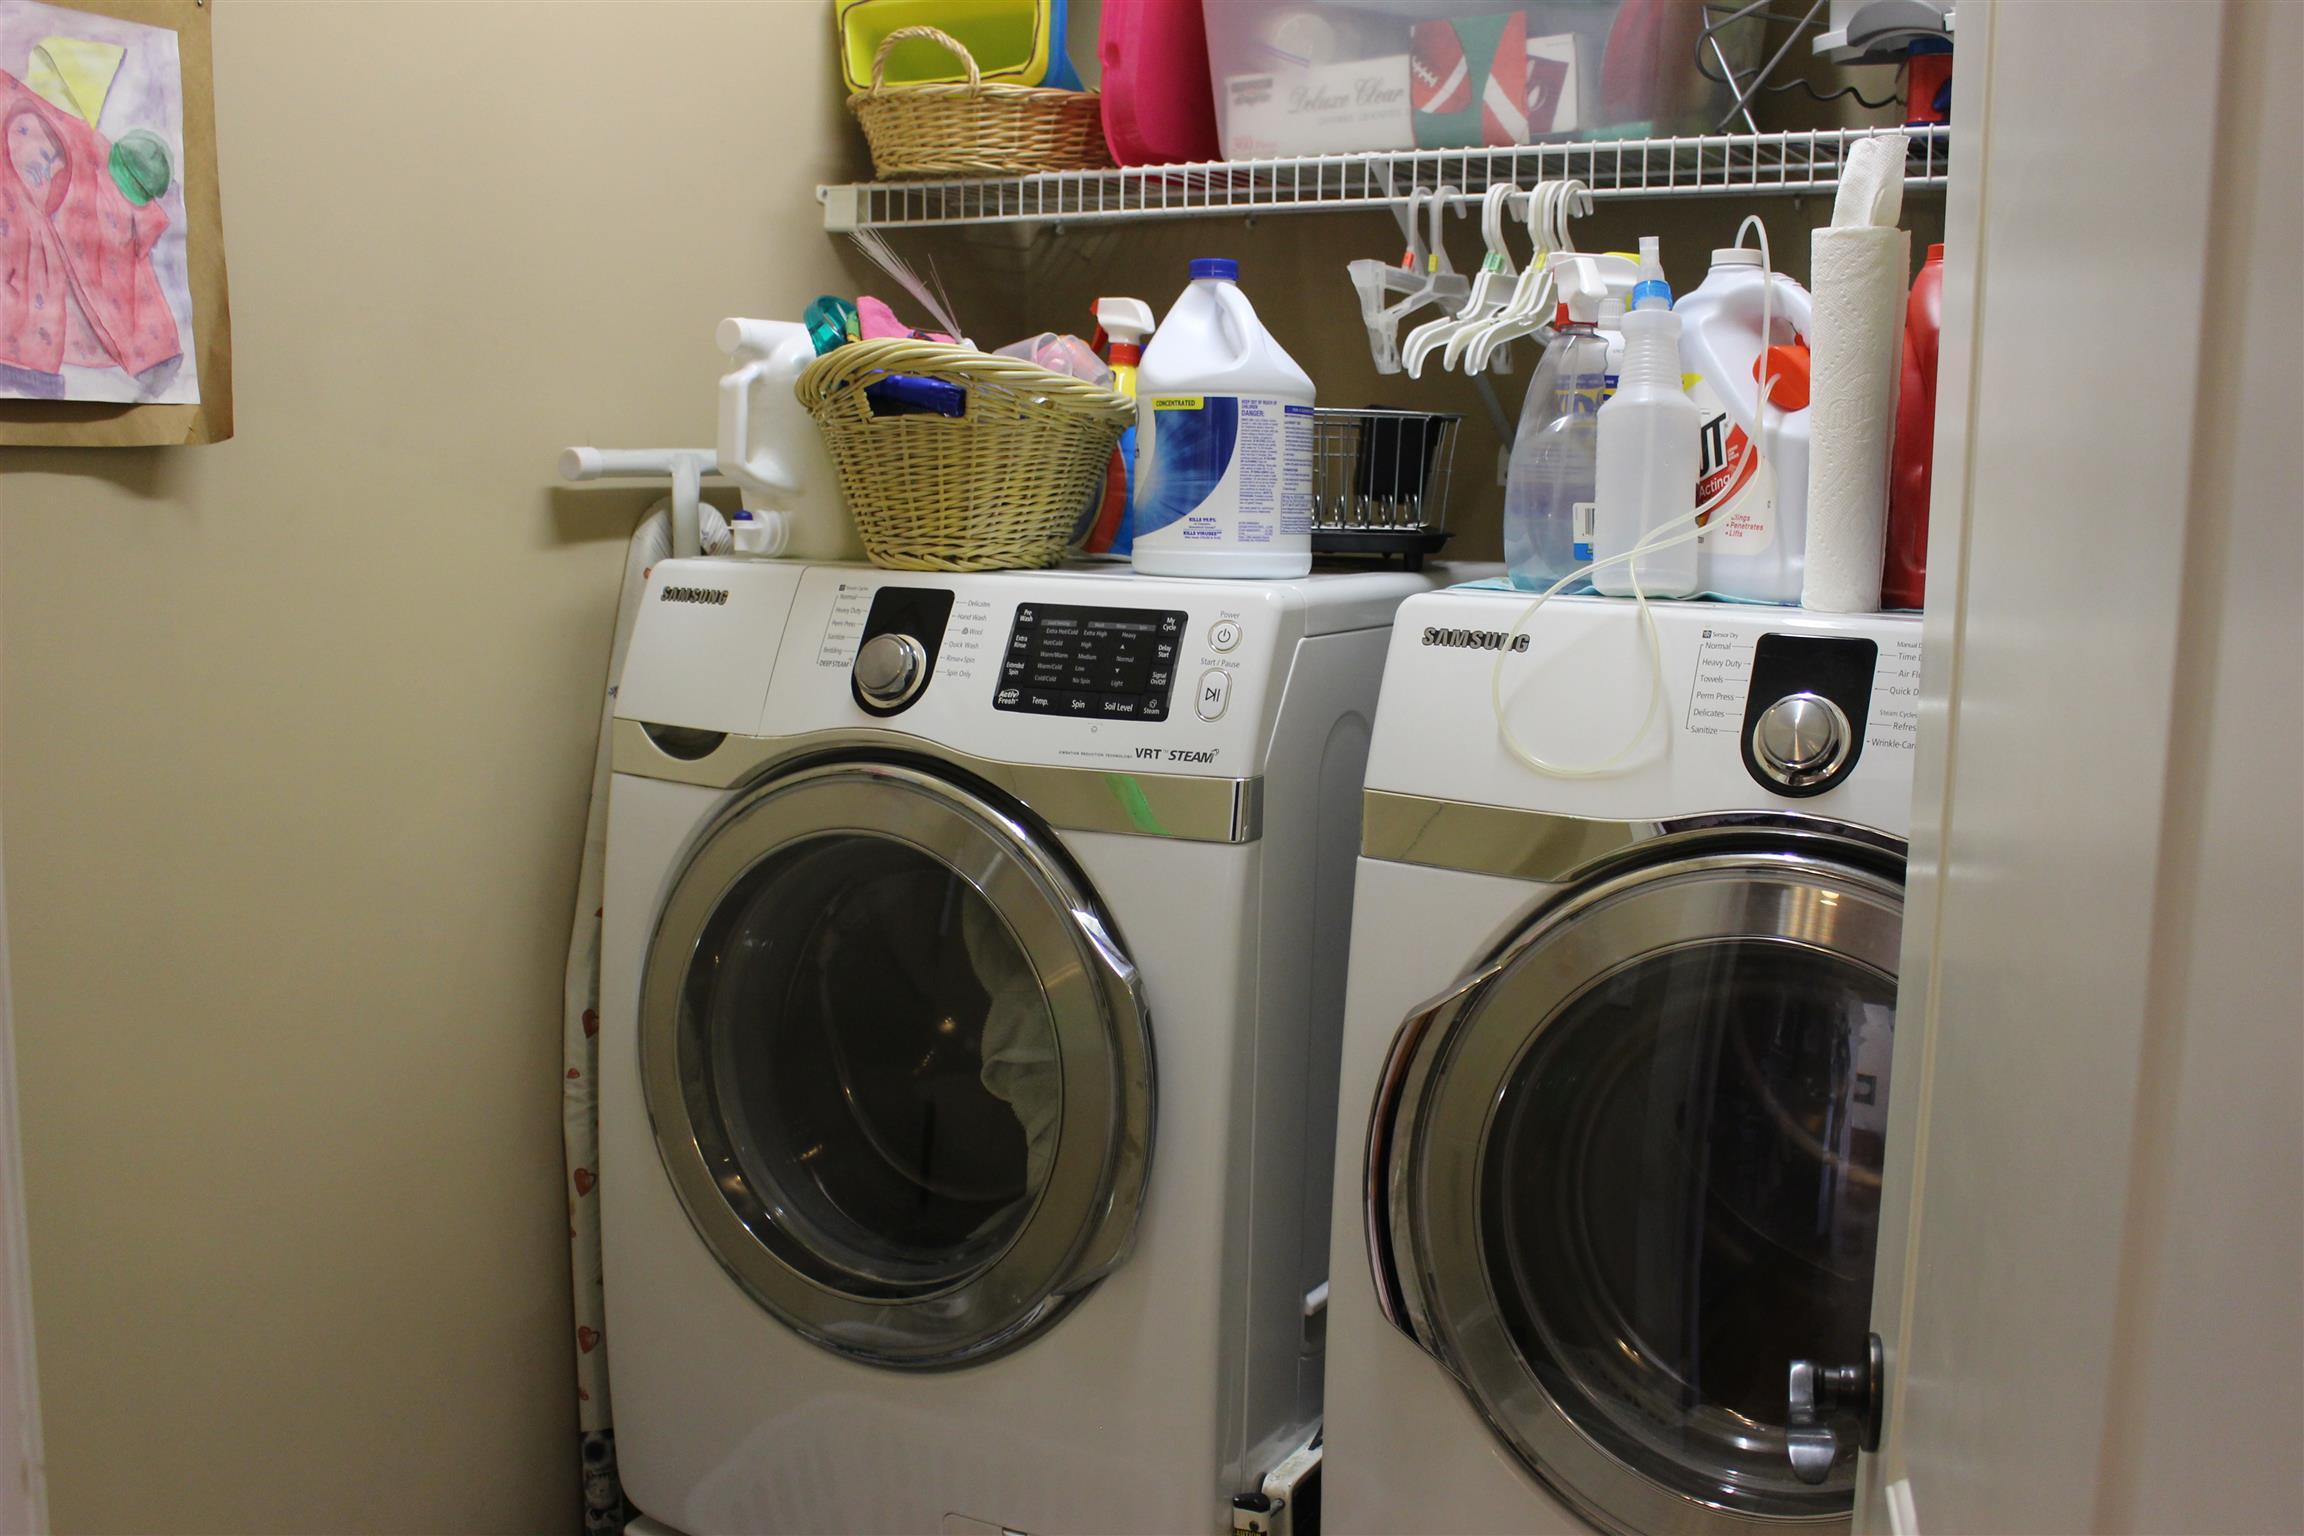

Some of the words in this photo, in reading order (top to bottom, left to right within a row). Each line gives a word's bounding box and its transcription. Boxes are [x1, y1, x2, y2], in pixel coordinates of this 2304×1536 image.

[1156, 400, 1196, 408] CONCENTRATED
[1730, 522, 1764, 531] Penetrates
[660, 586, 728, 606] SAMSUNG
[1220, 610, 1240, 619] Power
[1166, 617, 1175, 625] My
[1898, 652, 1916, 661] Time
[1200, 657, 1216, 666] Start
[1221, 659, 1240, 668] Pause
[1702, 658, 1724, 668] Heavy
[1726, 660, 1742, 669] Duty
[1700, 675, 1723, 683] Towels
[1890, 686, 1911, 696] Quick
[1696, 692, 1714, 700] Perm
[1716, 692, 1734, 701] Press
[1071, 700, 1086, 709] Spin
[1104, 702, 1116, 711] Soil
[1117, 703, 1133, 712] Level
[1694, 708, 1724, 718] Delicates
[1690, 725, 1718, 734] Sanitize
[1893, 722, 1917, 731] Refres
[1135, 748, 1163, 760] VRT
[1168, 750, 1215, 764] STEAM
